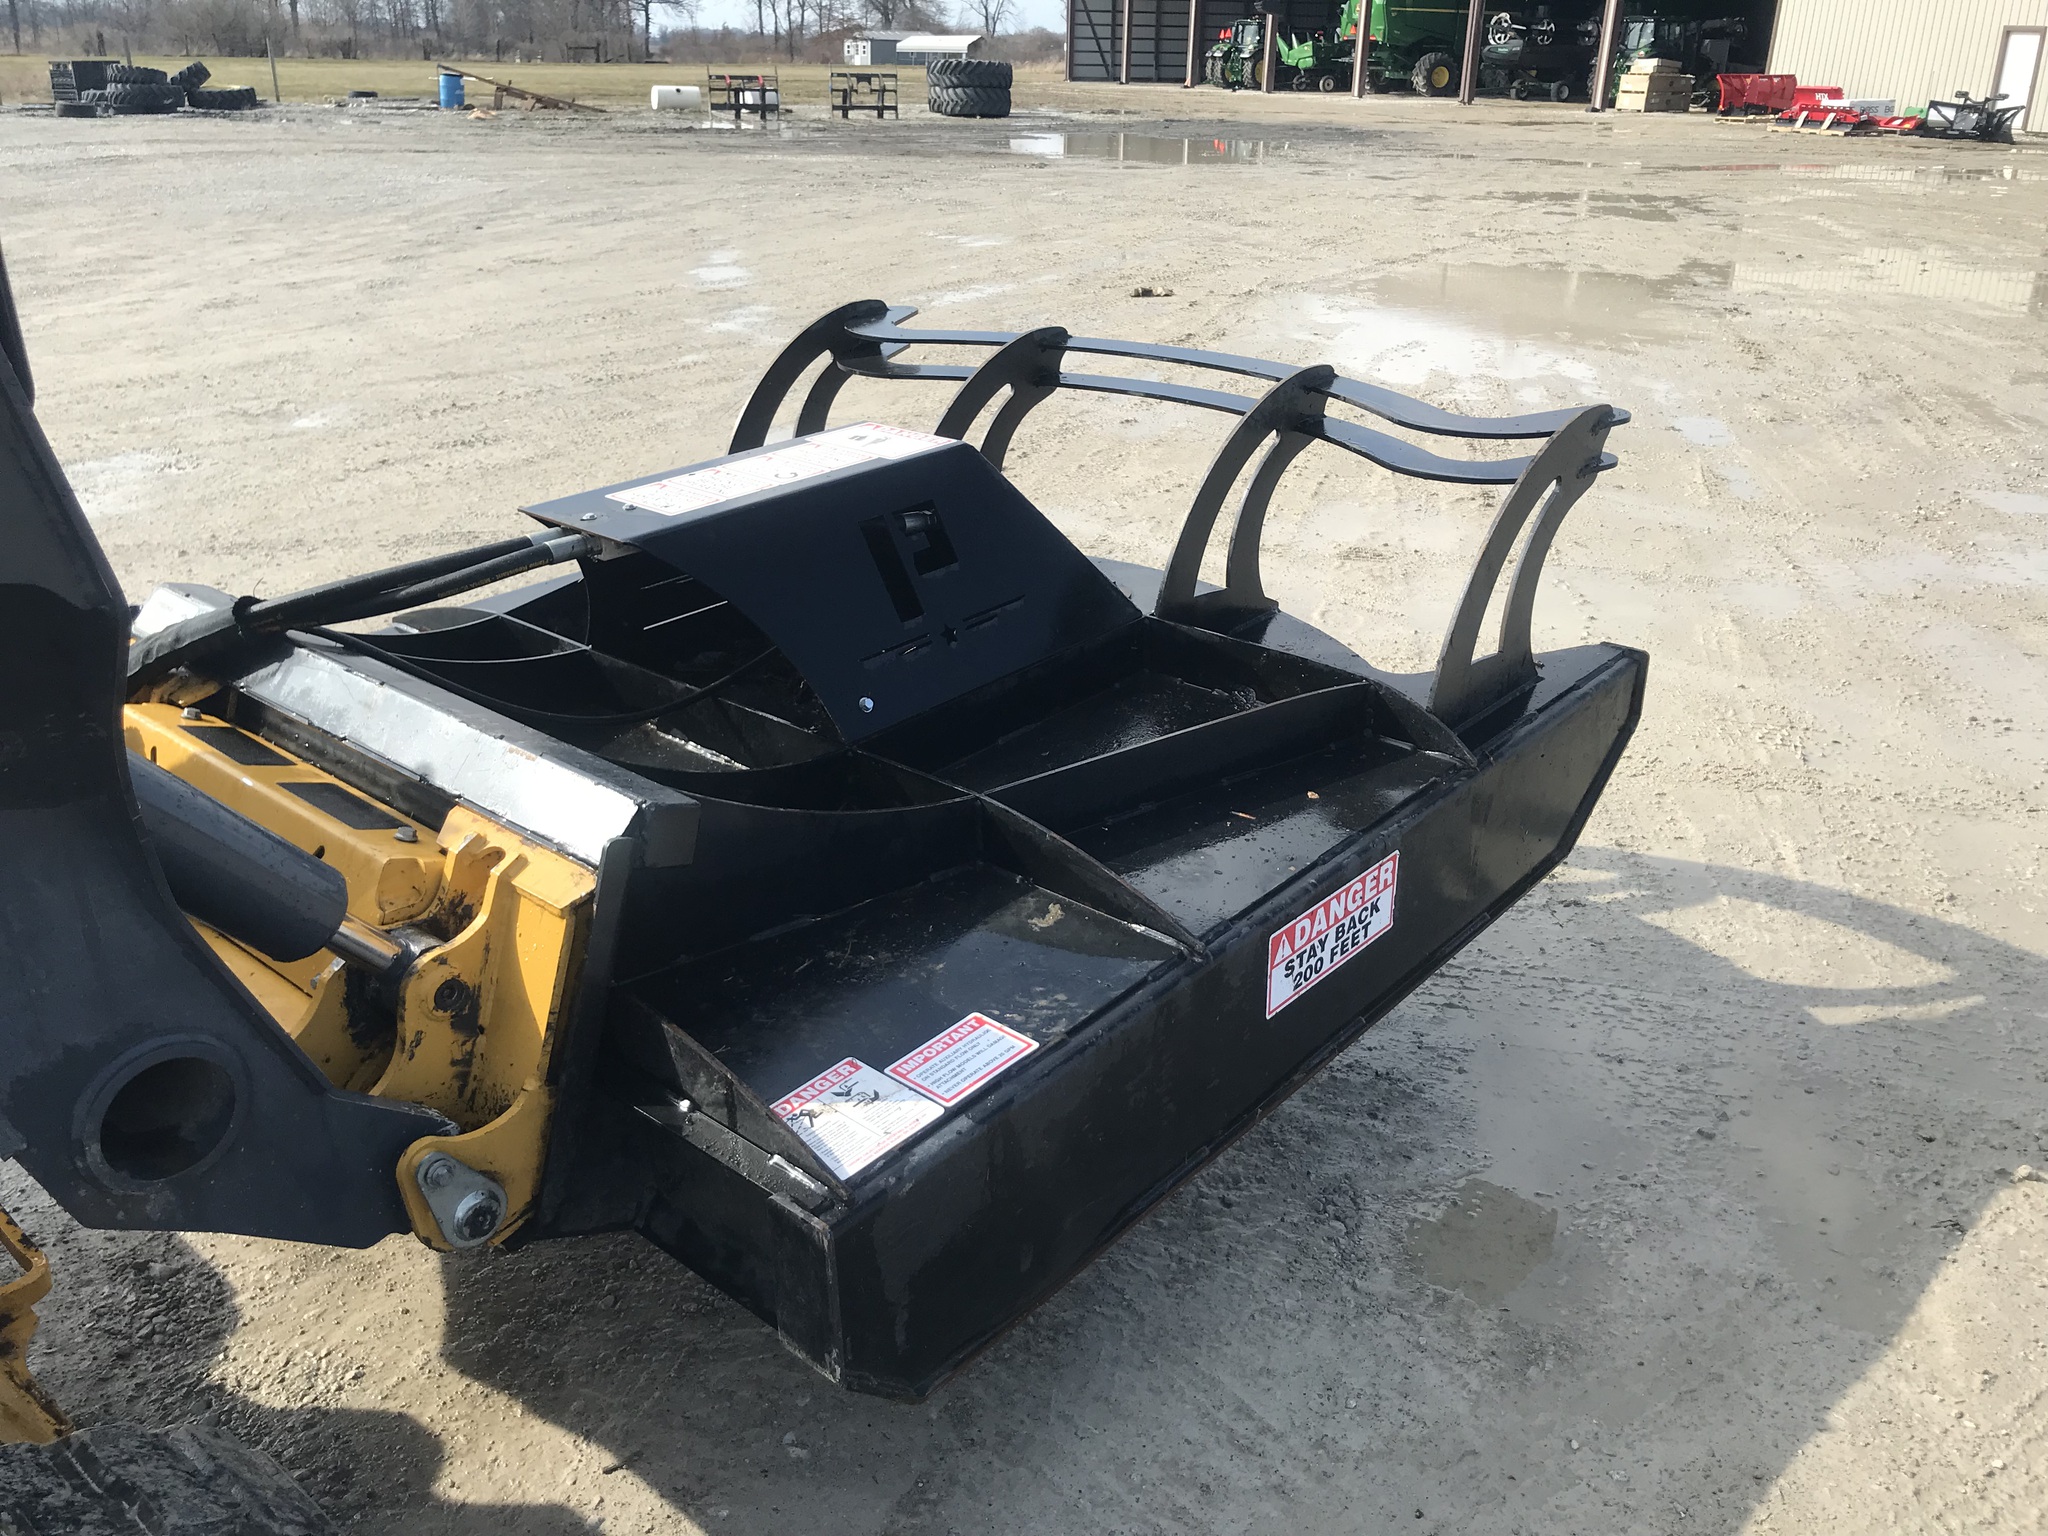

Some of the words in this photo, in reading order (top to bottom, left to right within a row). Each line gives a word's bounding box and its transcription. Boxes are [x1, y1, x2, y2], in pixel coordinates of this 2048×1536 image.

[1815, 93, 1829, 101] HTX
[1294, 860, 1394, 949] DANGER
[1283, 933, 1329, 979] STAY
[1335, 896, 1381, 943] BACK
[1292, 958, 1324, 992] 200
[1329, 920, 1371, 964] FEET
[895, 1018, 980, 1074] IMPORTANT
[929, 1058, 955, 1076] STANDARD
[953, 1049, 969, 1060] FLOW
[967, 1041, 981, 1051] ONLY
[929, 1076, 943, 1086] HIGH
[941, 1067, 957, 1077] FLOW
[955, 1054, 976, 1068] MODELS
[975, 1046, 988, 1055] WILL
[773, 1064, 856, 1116] DANGER
[915, 1062, 939, 1078] OPERATE
[935, 1067, 967, 1089] ATTACHMENT
[943, 1081, 961, 1093] NEVER
[960, 1066, 983, 1082] OPERATE
[981, 1055, 999, 1067] ABOVE
